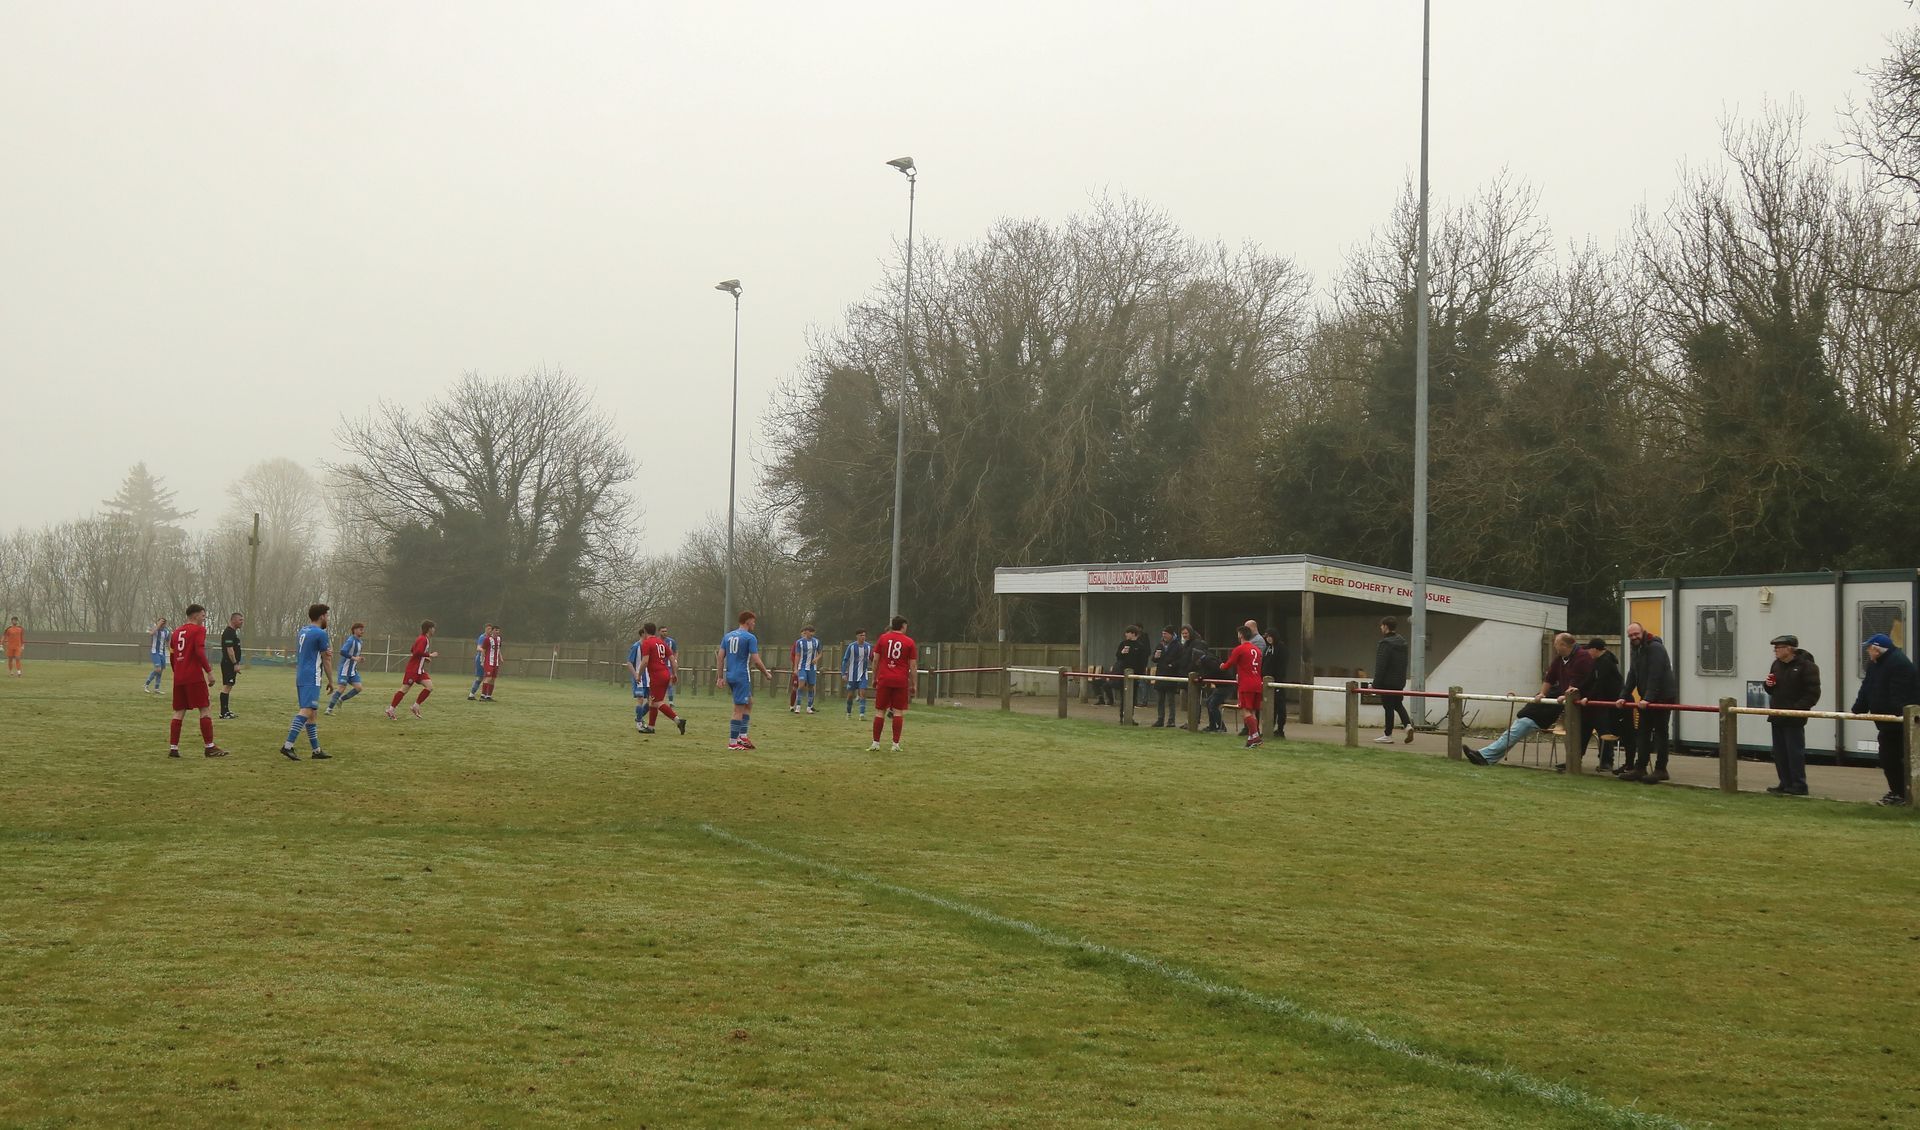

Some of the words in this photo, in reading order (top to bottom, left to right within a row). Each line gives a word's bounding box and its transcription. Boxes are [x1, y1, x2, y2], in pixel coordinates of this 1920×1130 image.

[1135, 572, 1156, 583] FOOTBALL
[1157, 571, 1168, 583] CLUB
[1312, 574, 1344, 586] ROGER
[1348, 579, 1394, 594] DOHERTY
[1397, 587, 1451, 604] ENCSURE
[177, 630, 187, 651] 5
[299, 633, 306, 652] 9
[728, 636, 739, 653] 10
[887, 639, 902, 659] 18
[655, 642, 666, 659] 19
[1250, 648, 1259, 666] 2
